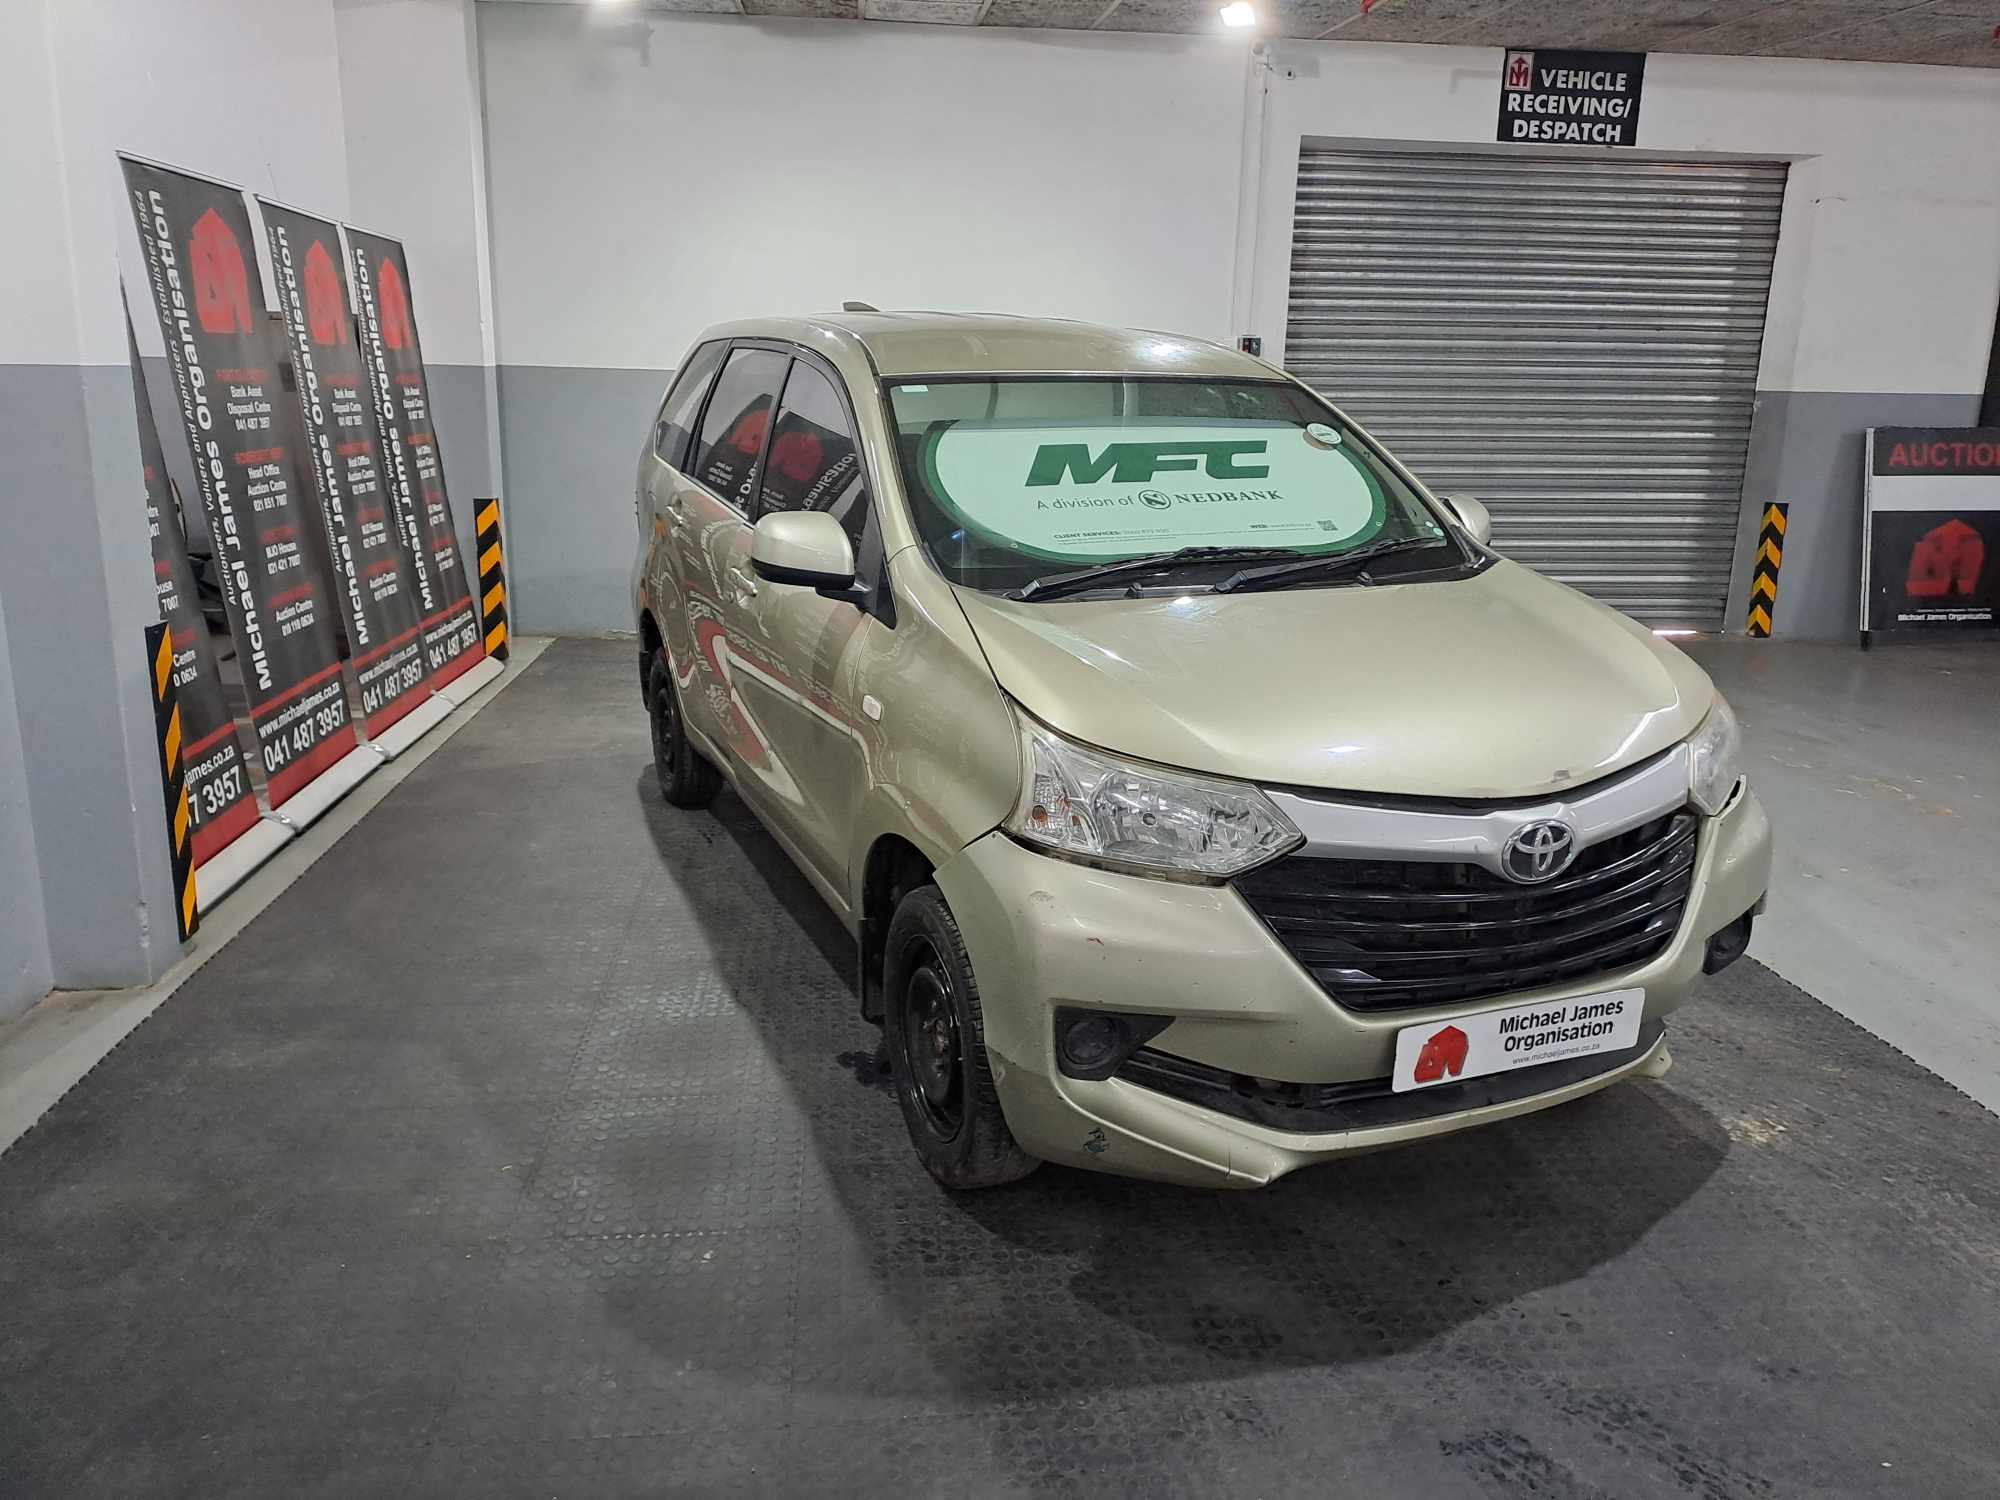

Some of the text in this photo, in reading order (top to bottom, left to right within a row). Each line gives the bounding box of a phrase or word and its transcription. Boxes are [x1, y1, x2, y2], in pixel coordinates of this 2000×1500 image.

[1507, 92, 1632, 118] RECEIVING/
[1540, 69, 1628, 92] VEHICLE
[1512, 119, 1622, 143] DESPATCH
[146, 236, 173, 326] Established
[277, 226, 323, 426] Organisation
[356, 248, 394, 420] Organisation
[169, 339, 194, 420] Appraisers
[149, 189, 273, 691] Michael James Organisation
[187, 424, 200, 452] and
[1025, 440, 1270, 487] MFC
[1888, 442, 2000, 466] AUCTIO
[197, 457, 214, 511] Valuers
[319, 434, 345, 528] James
[389, 428, 412, 508] James
[1037, 490, 1285, 510] A division of NEDBANK
[405, 514, 433, 610] Michael
[337, 535, 369, 645] Michael
[430, 643, 447, 668] 041
[447, 633, 460, 657] 487
[363, 657, 422, 713] 041 487 3957
[264, 698, 345, 772] 041 487 3957
[202, 765, 241, 813] 3957
[1499, 1000, 1624, 1034] Michael James
[1504, 1018, 1614, 1052] Organisation
